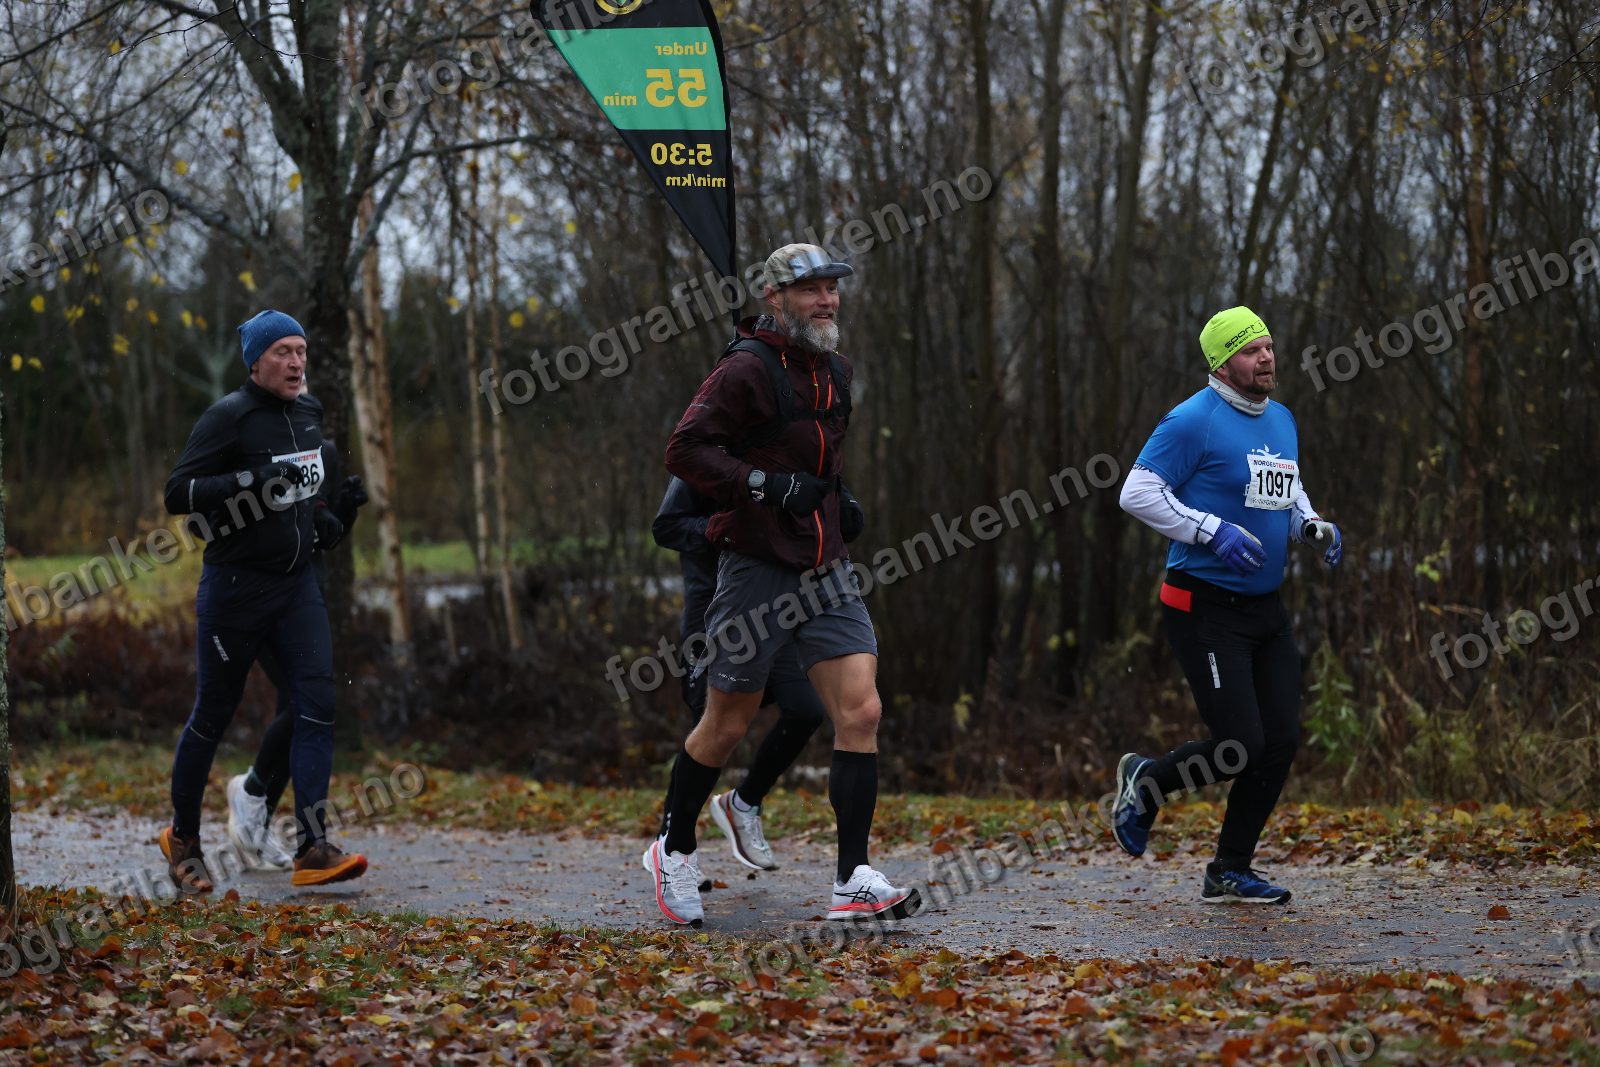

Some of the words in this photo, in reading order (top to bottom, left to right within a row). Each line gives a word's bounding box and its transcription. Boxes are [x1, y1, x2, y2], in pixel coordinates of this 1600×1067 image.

[294, 463, 320, 489] 86
[1253, 459, 1295, 470] NORGESTESTEN
[1256, 469, 1295, 499] 1097
